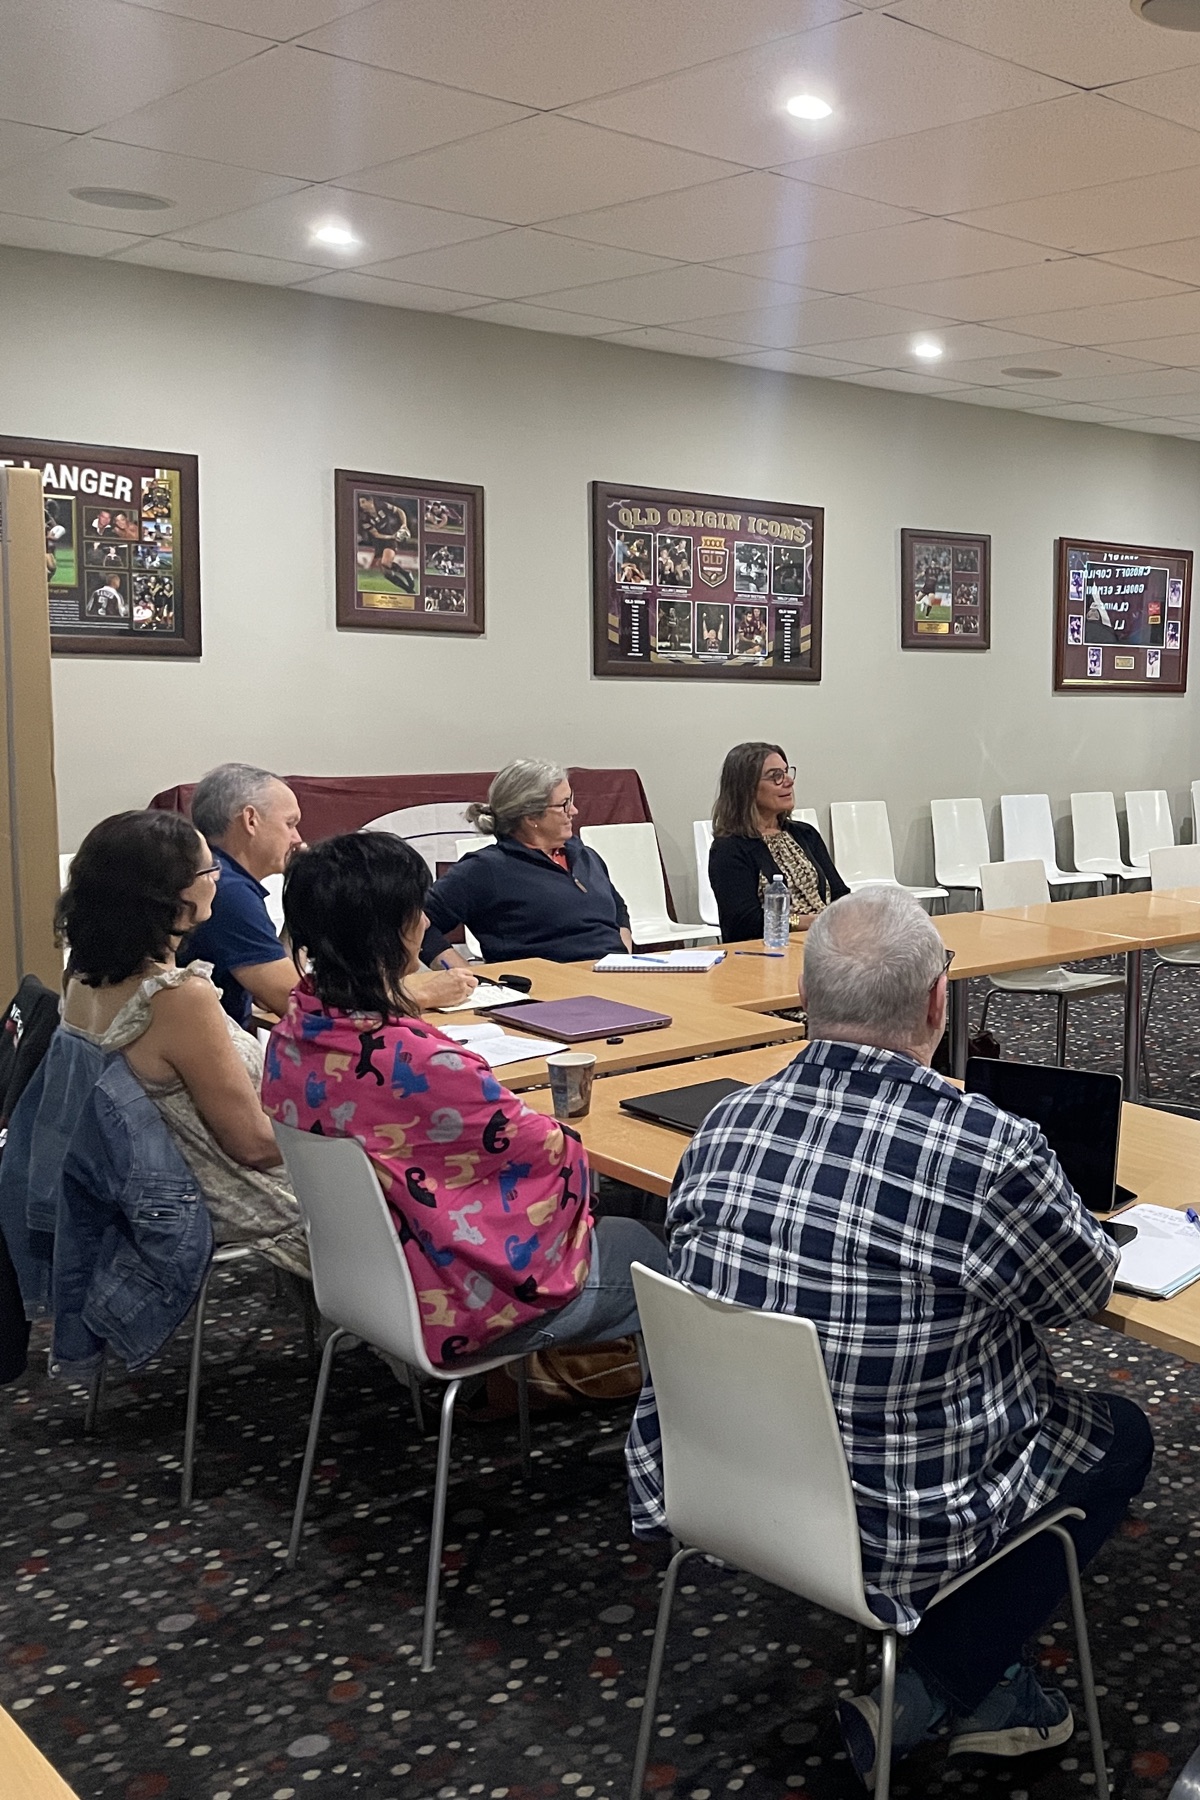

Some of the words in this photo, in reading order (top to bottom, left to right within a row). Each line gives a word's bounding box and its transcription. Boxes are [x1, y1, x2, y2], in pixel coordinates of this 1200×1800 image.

[23, 460, 133, 503] ANGER
[618, 507, 661, 530] QLD
[667, 508, 742, 532] ORIGIN
[747, 516, 807, 544] ICONS
[702, 554, 724, 565] QLD
